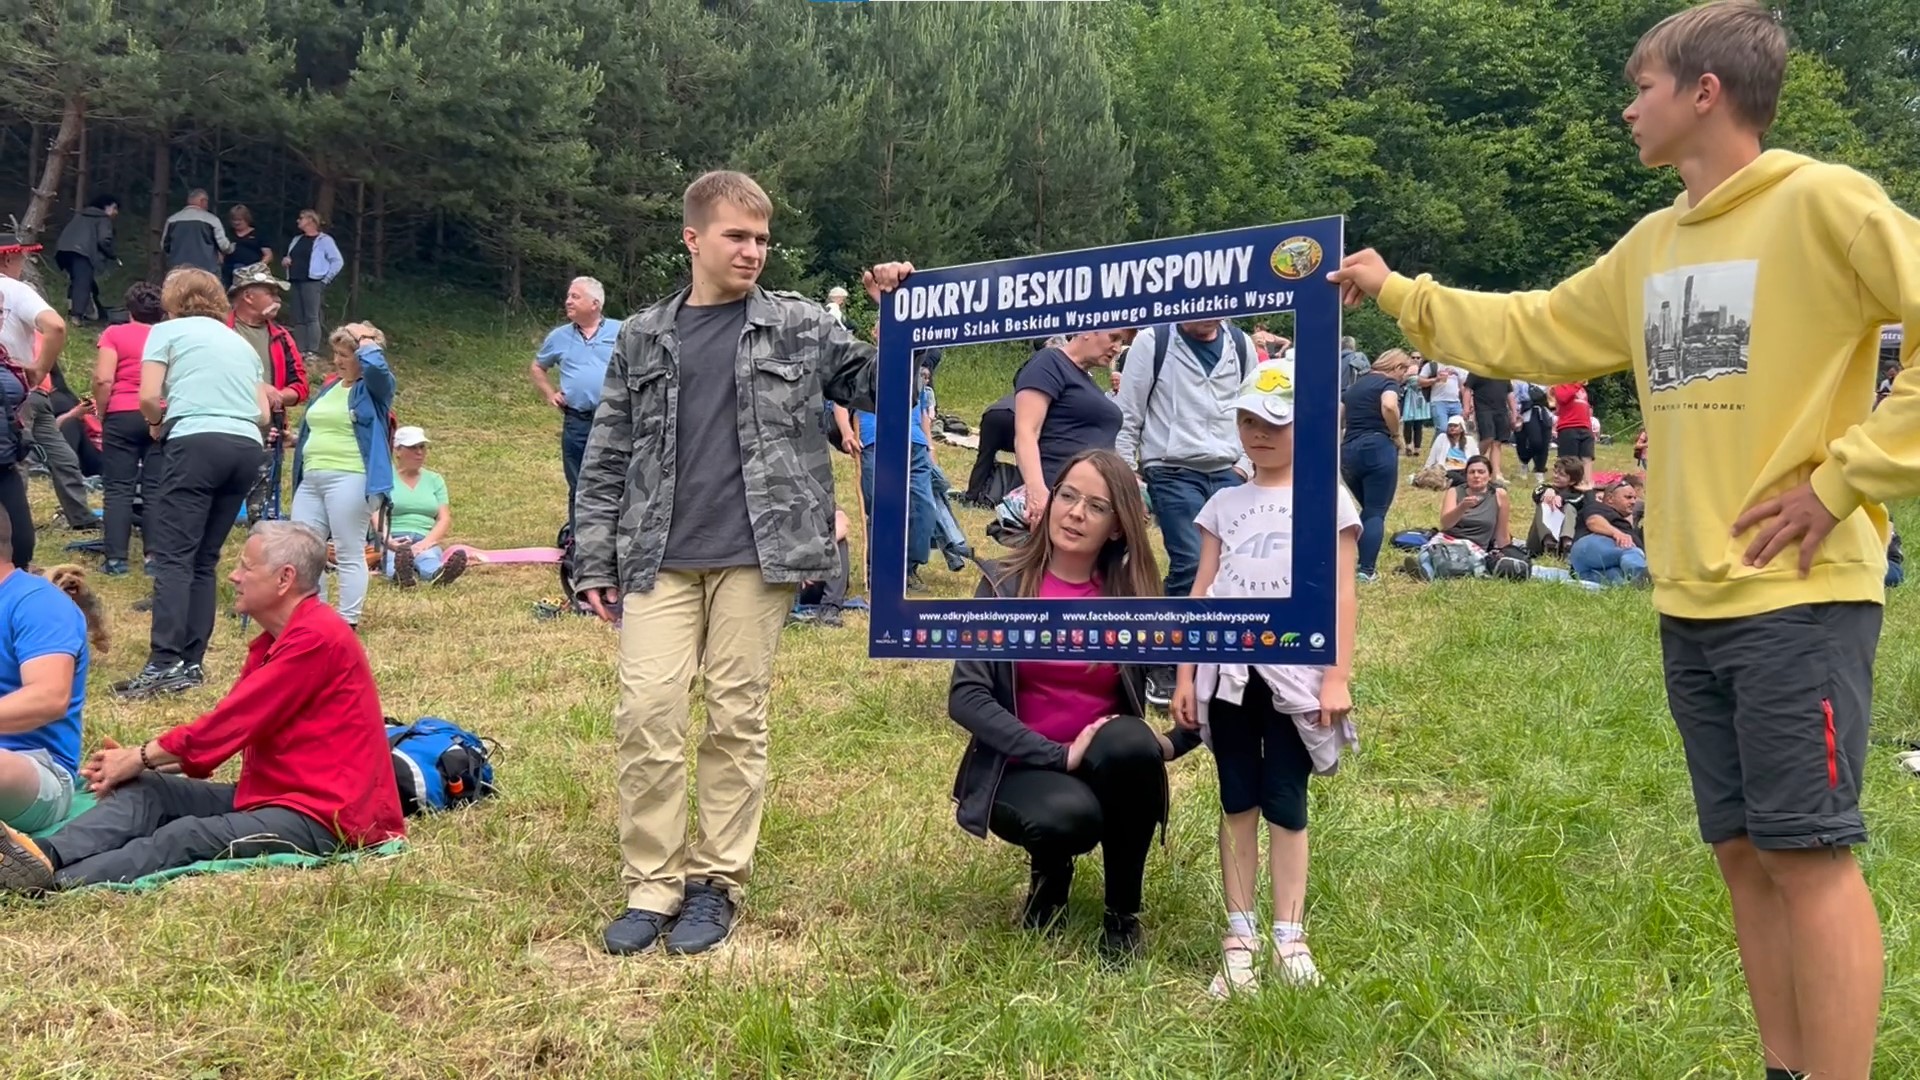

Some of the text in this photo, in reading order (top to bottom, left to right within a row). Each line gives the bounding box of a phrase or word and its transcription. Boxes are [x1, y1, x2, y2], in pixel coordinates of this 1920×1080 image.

[894, 277, 990, 323] ODKRYJ
[998, 266, 1093, 311] BESKID
[1100, 245, 1254, 299] WYSPOWY
[912, 290, 1295, 343] Główny Szlak Beskidu Wyspowego Beskidzkie Wyspy
[1683, 402, 1698, 410] THE
[1227, 504, 1292, 535] SPORTSW
[919, 611, 1270, 624] www.odkryjbeskidwyspowy.pl www.facebook.com/odkryjbeskidwyspowy
